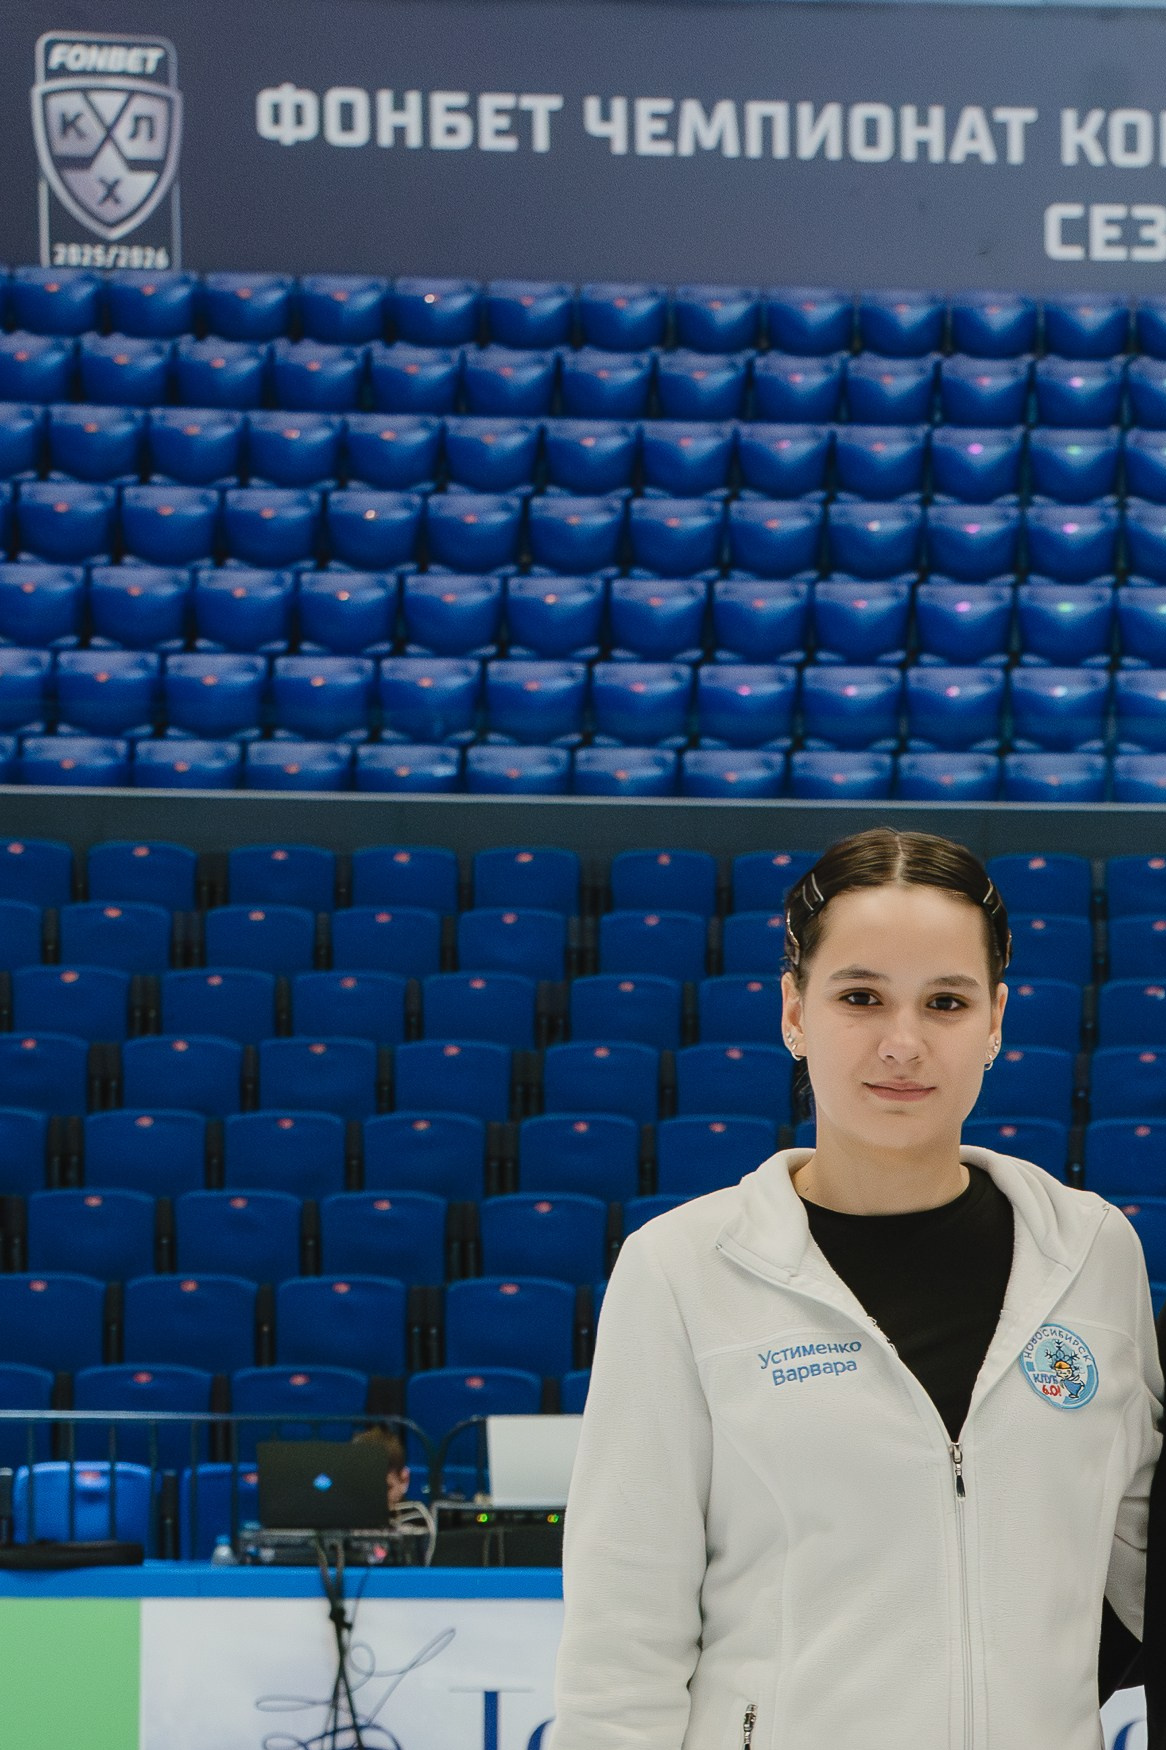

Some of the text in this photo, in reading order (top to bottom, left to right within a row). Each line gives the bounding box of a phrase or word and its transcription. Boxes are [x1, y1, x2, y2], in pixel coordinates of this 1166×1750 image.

[49, 44, 164, 74] FONBET
[256, 83, 563, 152] ФОНБЕТ
[583, 95, 1038, 165] ЧЕМПИОНАТ
[758, 1341, 862, 1369] Устименко
[1024, 1328, 1092, 1362] НОВОСИБИРСК
[772, 1360, 857, 1386] Варвара
[1033, 1373, 1058, 1385] КЛУБ
